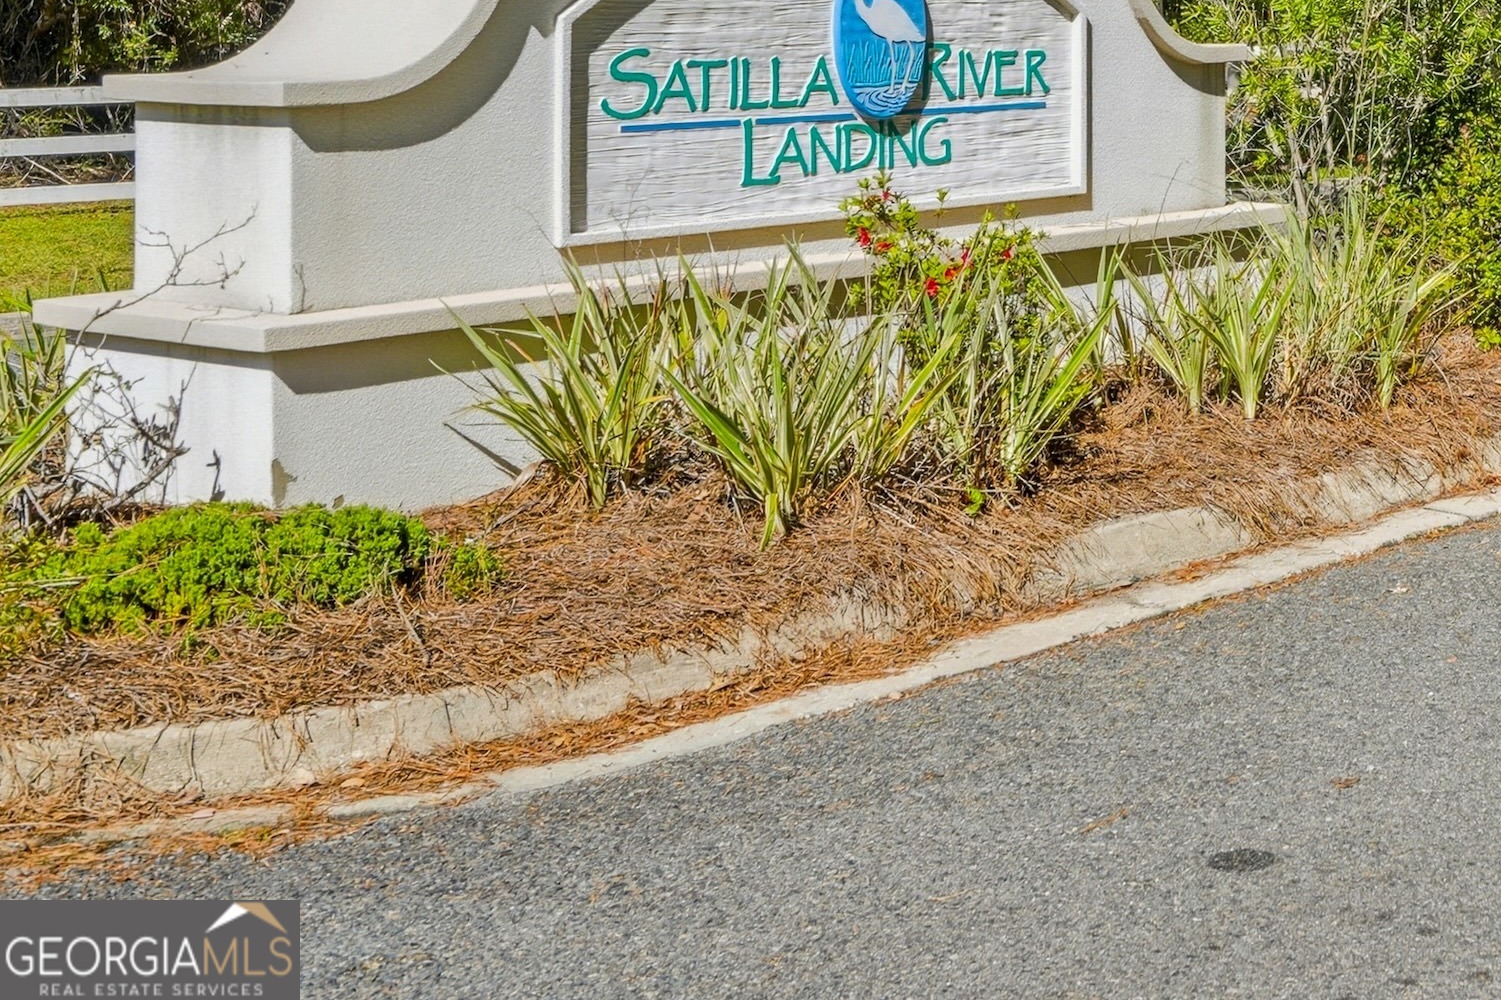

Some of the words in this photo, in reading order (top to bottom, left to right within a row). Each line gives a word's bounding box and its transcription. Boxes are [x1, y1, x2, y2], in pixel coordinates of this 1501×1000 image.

[601, 47, 839, 120] SATILLA
[927, 41, 1050, 102] RIVER
[740, 116, 952, 188] LANDING
